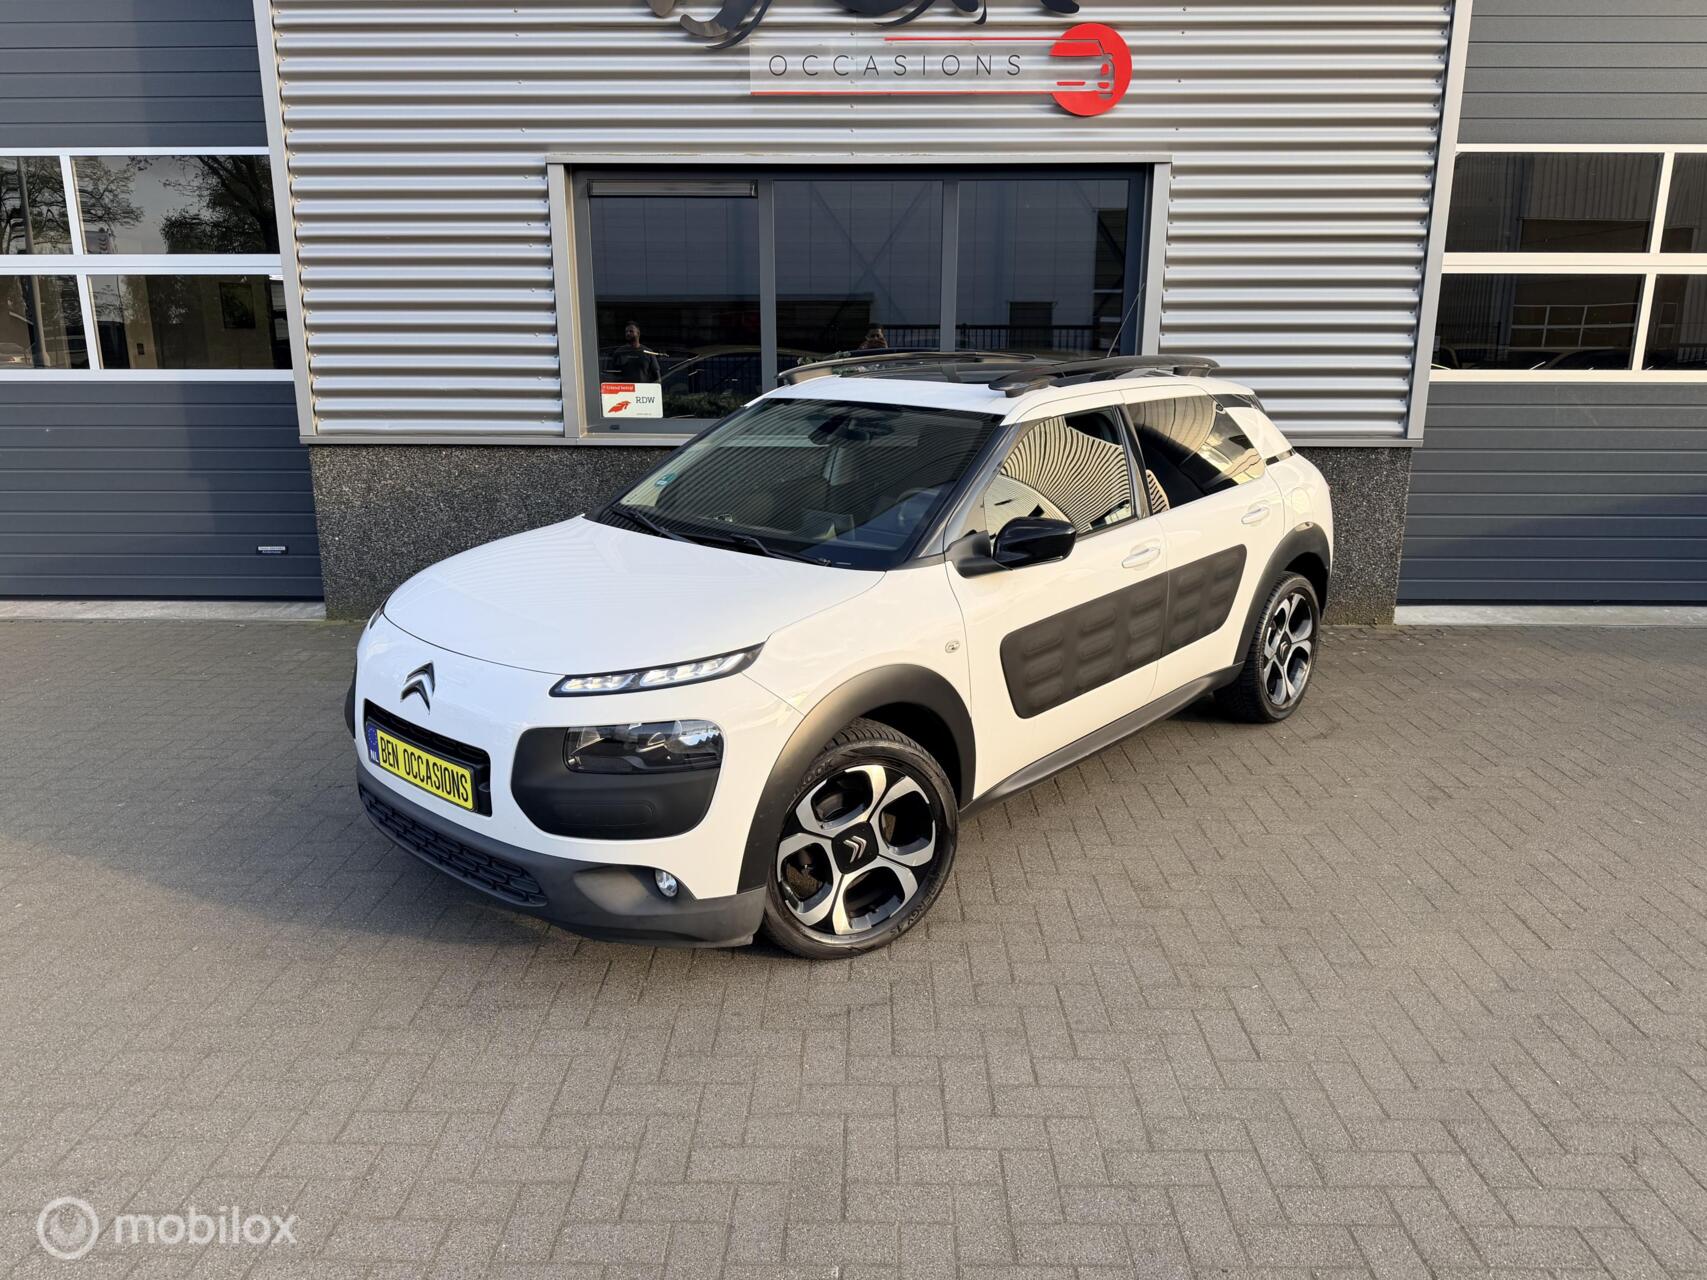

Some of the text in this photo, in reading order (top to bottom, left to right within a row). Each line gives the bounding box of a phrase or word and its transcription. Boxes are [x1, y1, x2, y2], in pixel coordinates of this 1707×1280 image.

[768, 54, 1023, 77] OCCASIONS
[635, 396, 656, 404] RDW
[369, 749, 380, 763] NL
[380, 736, 470, 803] BEN OCCASIONS
